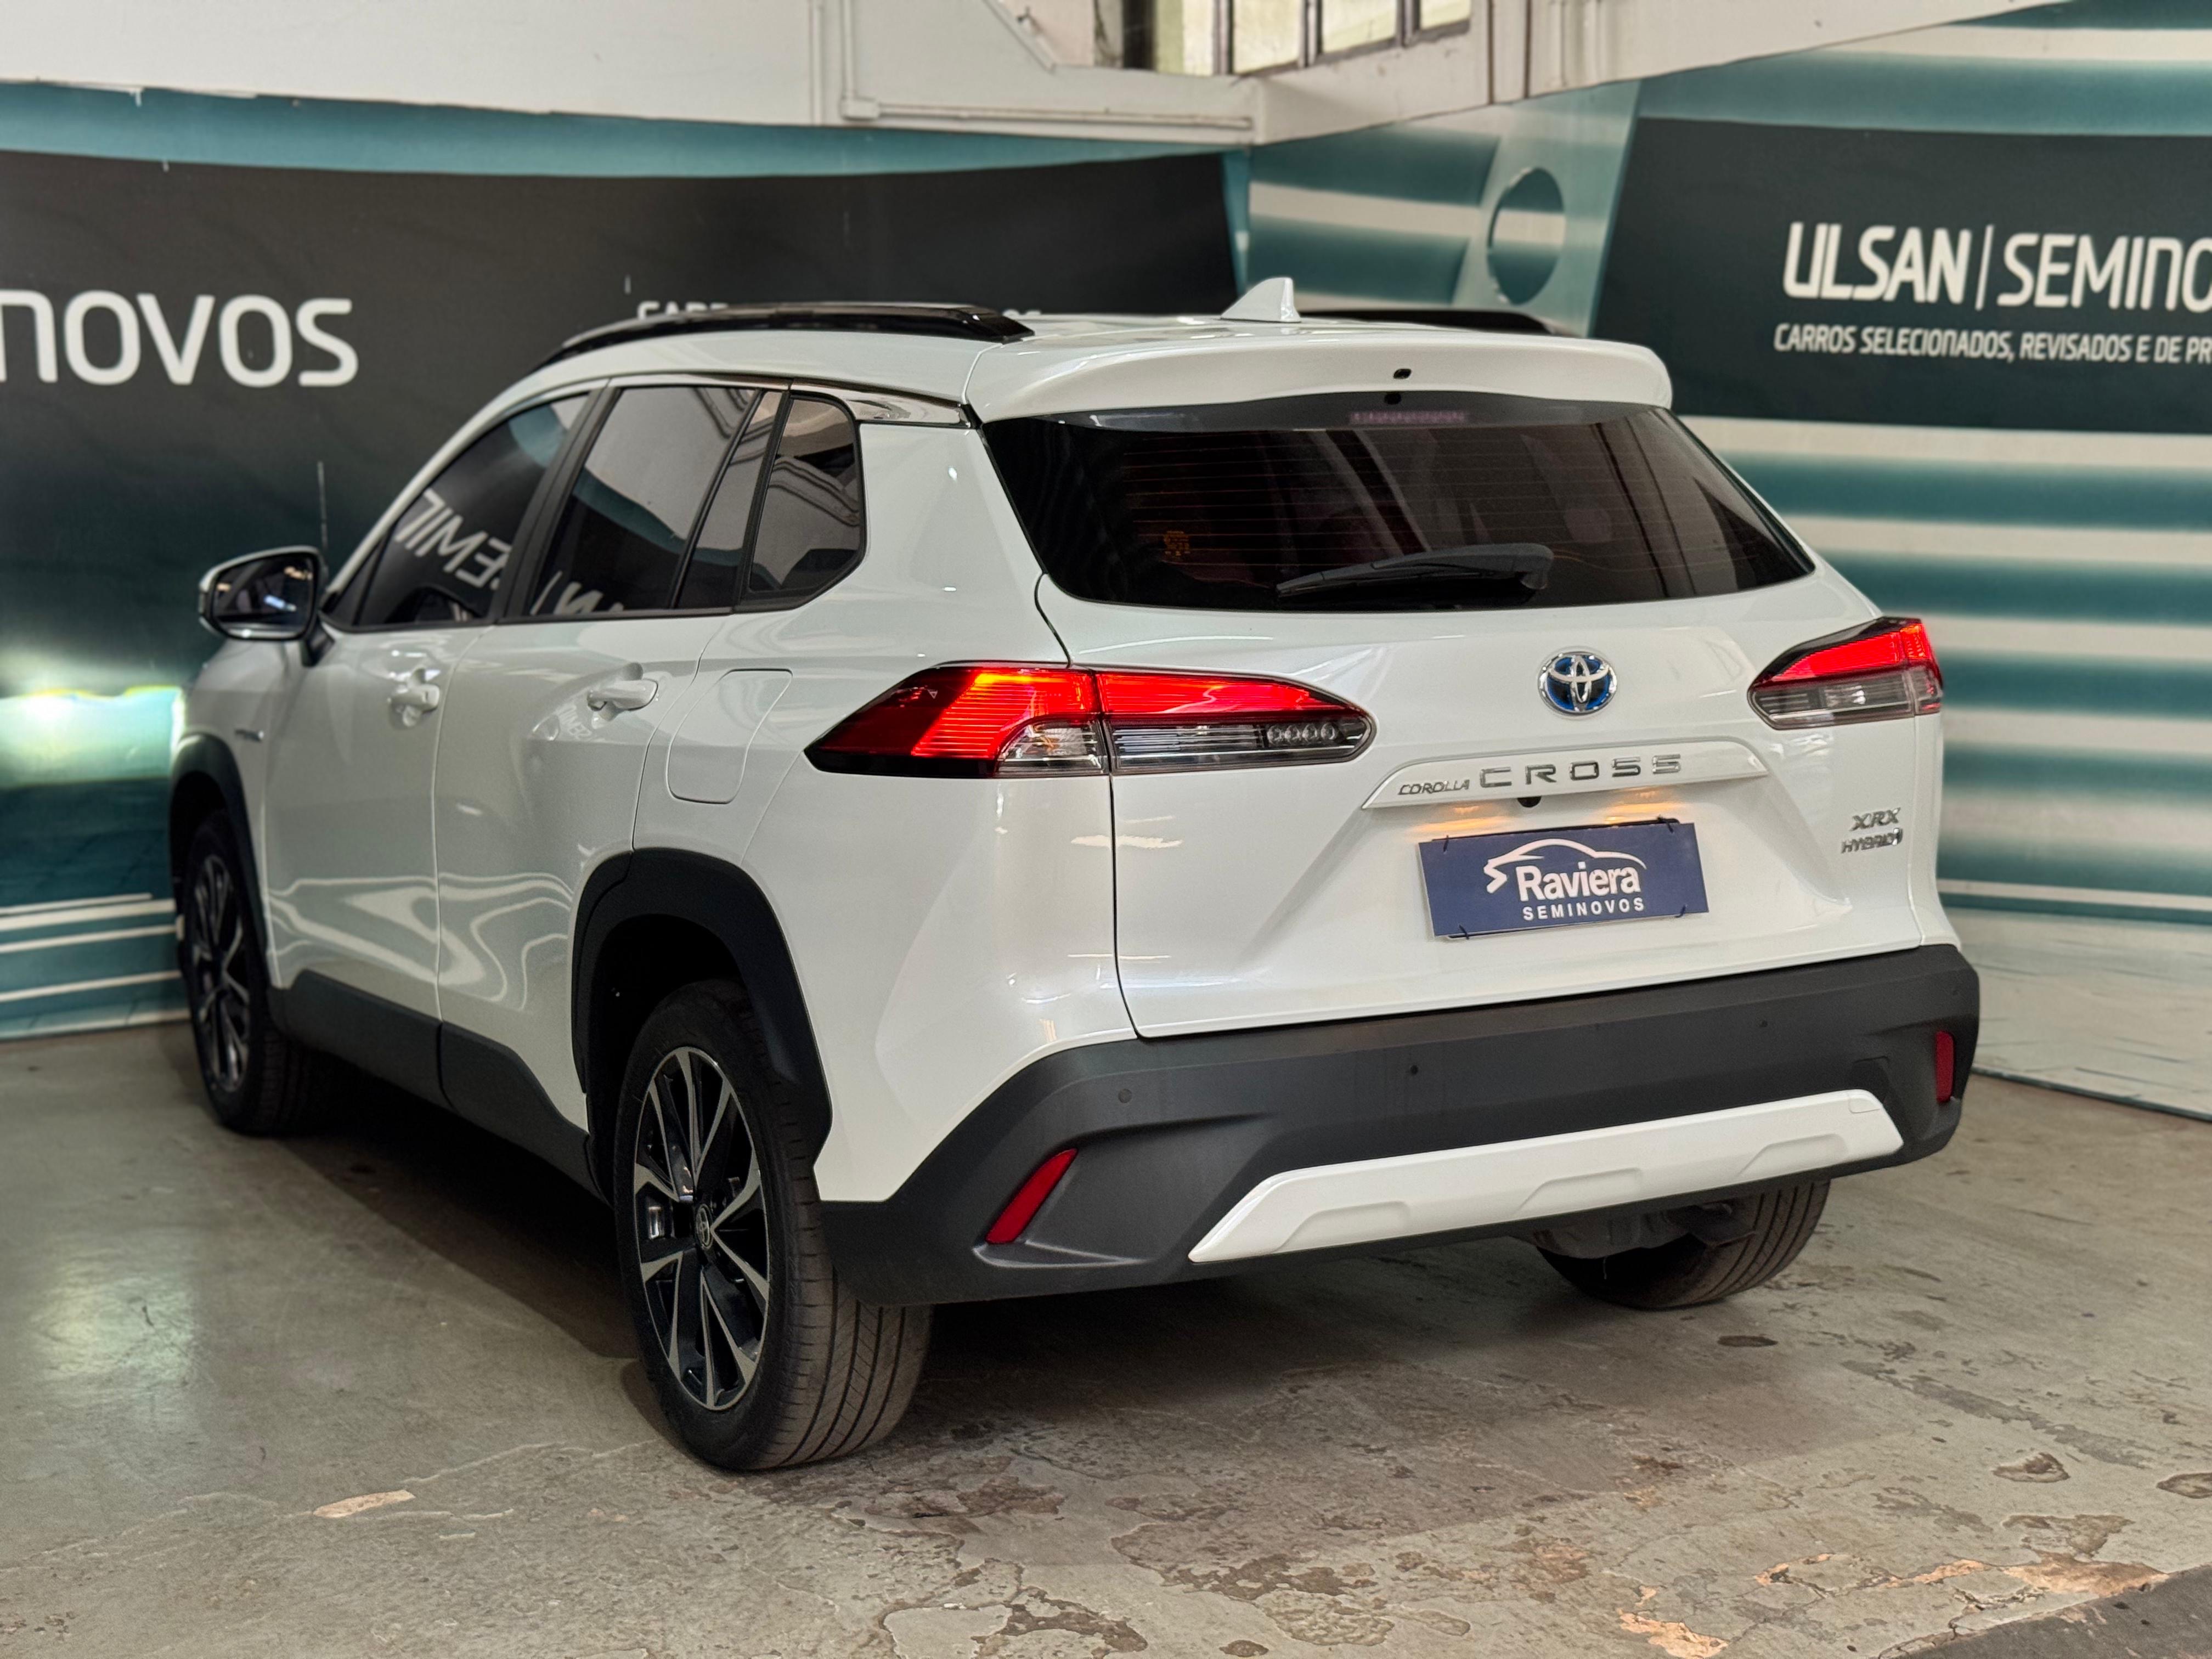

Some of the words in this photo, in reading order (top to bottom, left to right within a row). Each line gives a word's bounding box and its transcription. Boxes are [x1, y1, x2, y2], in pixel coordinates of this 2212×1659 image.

[1783, 222, 1972, 304] ULSAN
[1774, 323, 1858, 353] CARROS
[1859, 326, 2015, 363] SELECIONADOS,
[2019, 332, 2133, 363] REVISADOS
[2135, 335, 2151, 363] E
[2153, 336, 2183, 363] DE
[1398, 779, 1470, 795] COROLLA
[1480, 753, 1682, 788] CROSS
[1849, 807, 1901, 831] XRX
[1841, 832, 1898, 854] HYBRID
[1516, 862, 1641, 902] Raviera
[1522, 898, 1645, 922] SEMINOVOS
